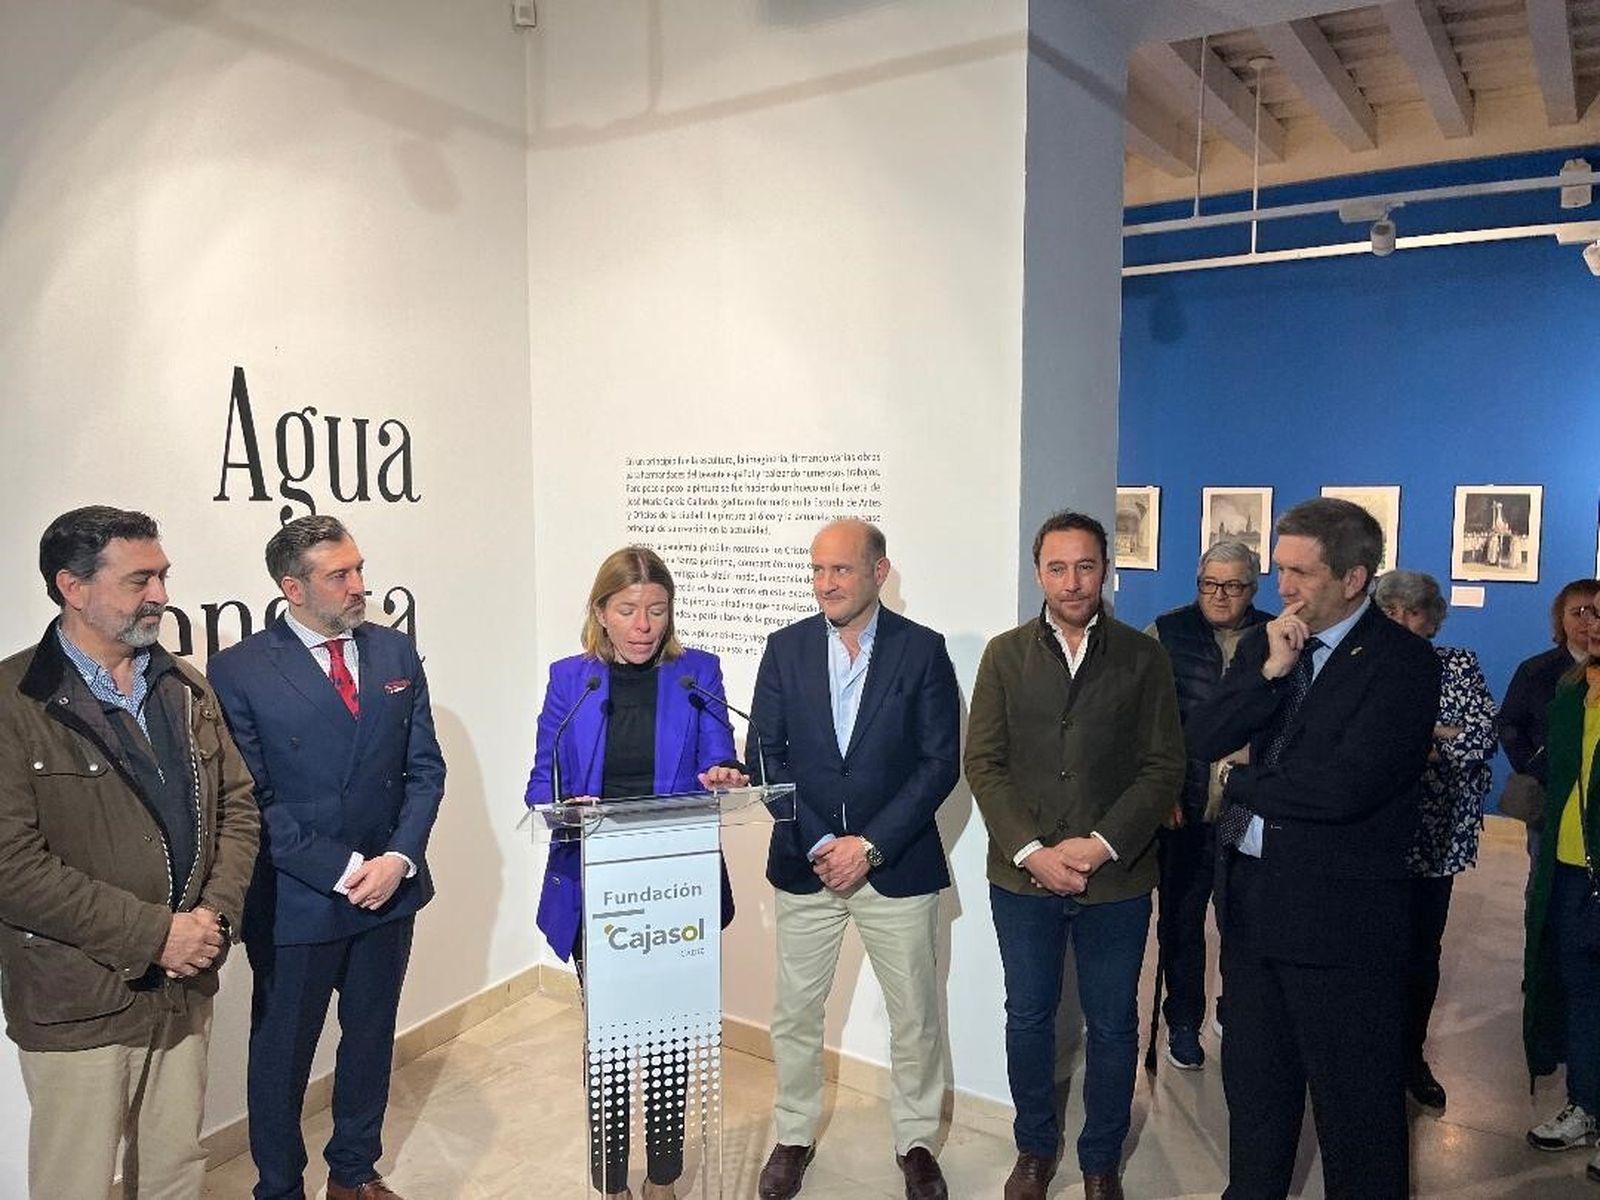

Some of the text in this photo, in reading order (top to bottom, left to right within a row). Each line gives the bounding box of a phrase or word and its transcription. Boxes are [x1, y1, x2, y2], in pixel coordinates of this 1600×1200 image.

[213, 366, 421, 527] Agua
[604, 883, 702, 906] Fundación
[608, 918, 705, 954] Cajasol
